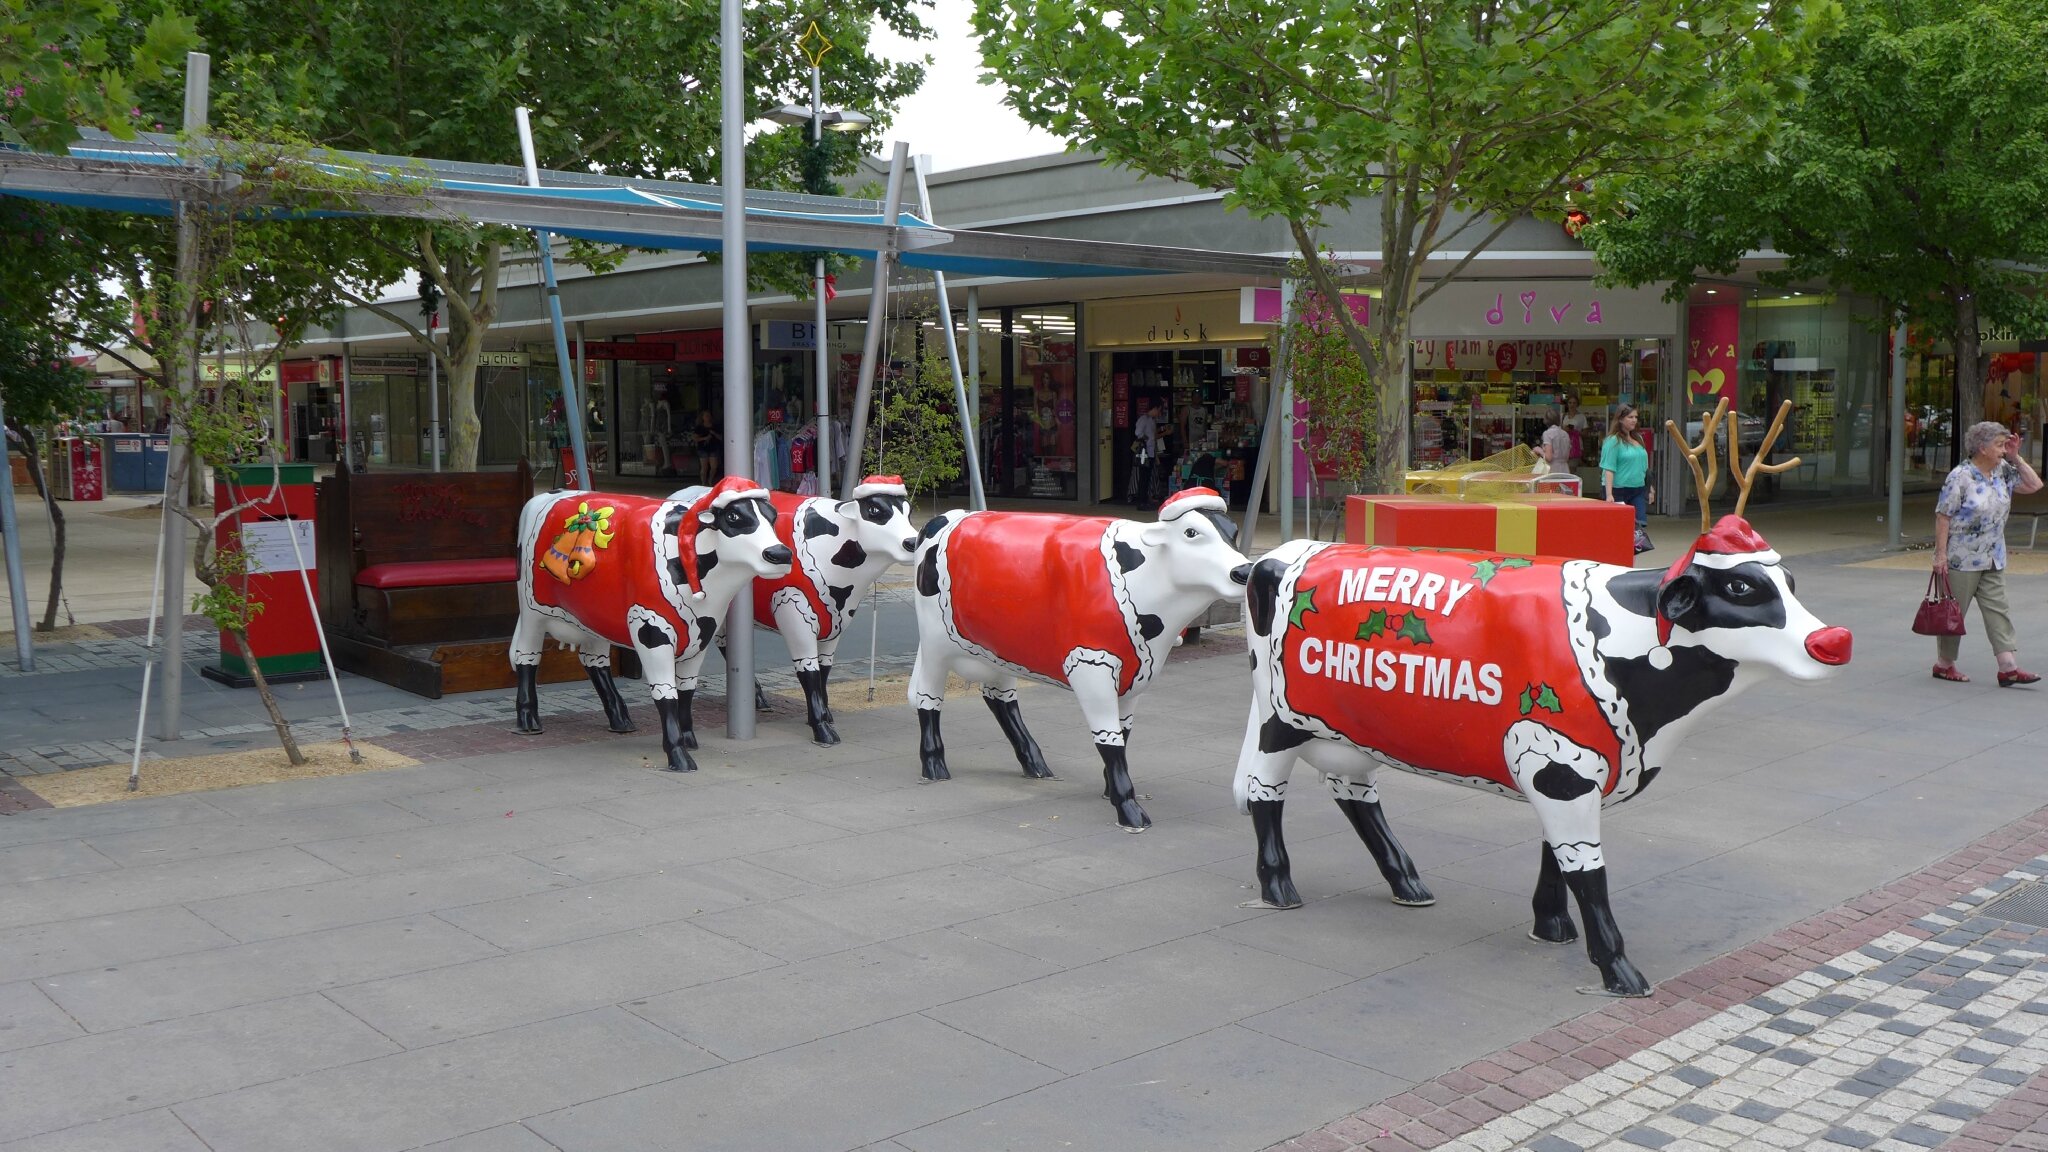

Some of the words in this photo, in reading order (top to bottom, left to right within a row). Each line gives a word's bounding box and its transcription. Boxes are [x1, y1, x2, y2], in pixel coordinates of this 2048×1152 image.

[1485, 290, 1602, 325] diva
[1147, 322, 1207, 342] dusk
[479, 353, 490, 366] ty
[494, 353, 519, 365] chic
[1691, 339, 1736, 359] iva
[1337, 566, 1475, 617] MERRY
[1299, 637, 1503, 706] CHRISTMAS
